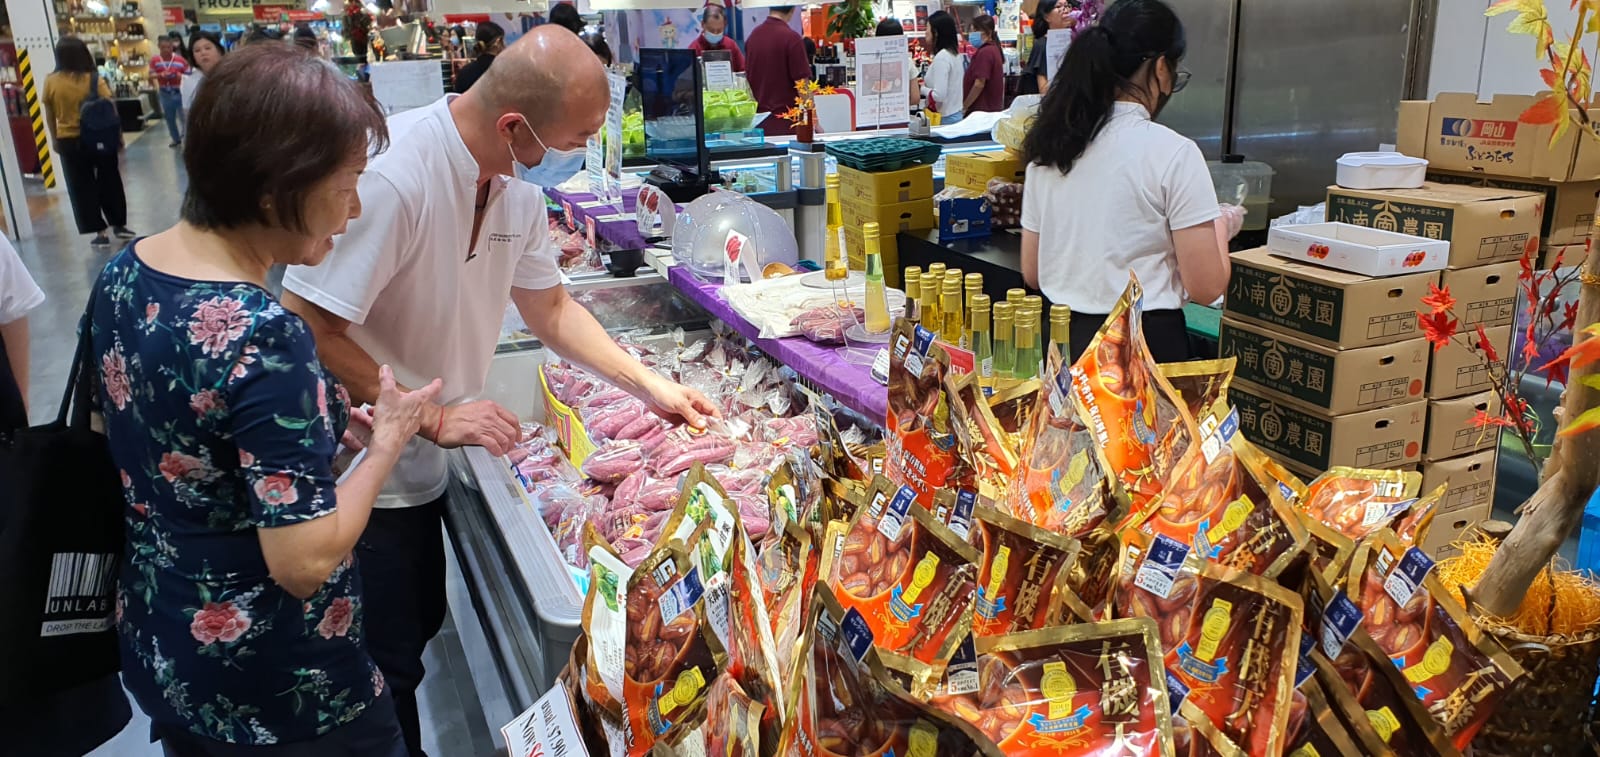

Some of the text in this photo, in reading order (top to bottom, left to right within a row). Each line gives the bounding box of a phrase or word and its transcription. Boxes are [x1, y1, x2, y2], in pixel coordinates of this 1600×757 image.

[1480, 121, 1506, 138] 岡山
[1231, 277, 1267, 309] 小南
[46, 623, 73, 633] DROP
